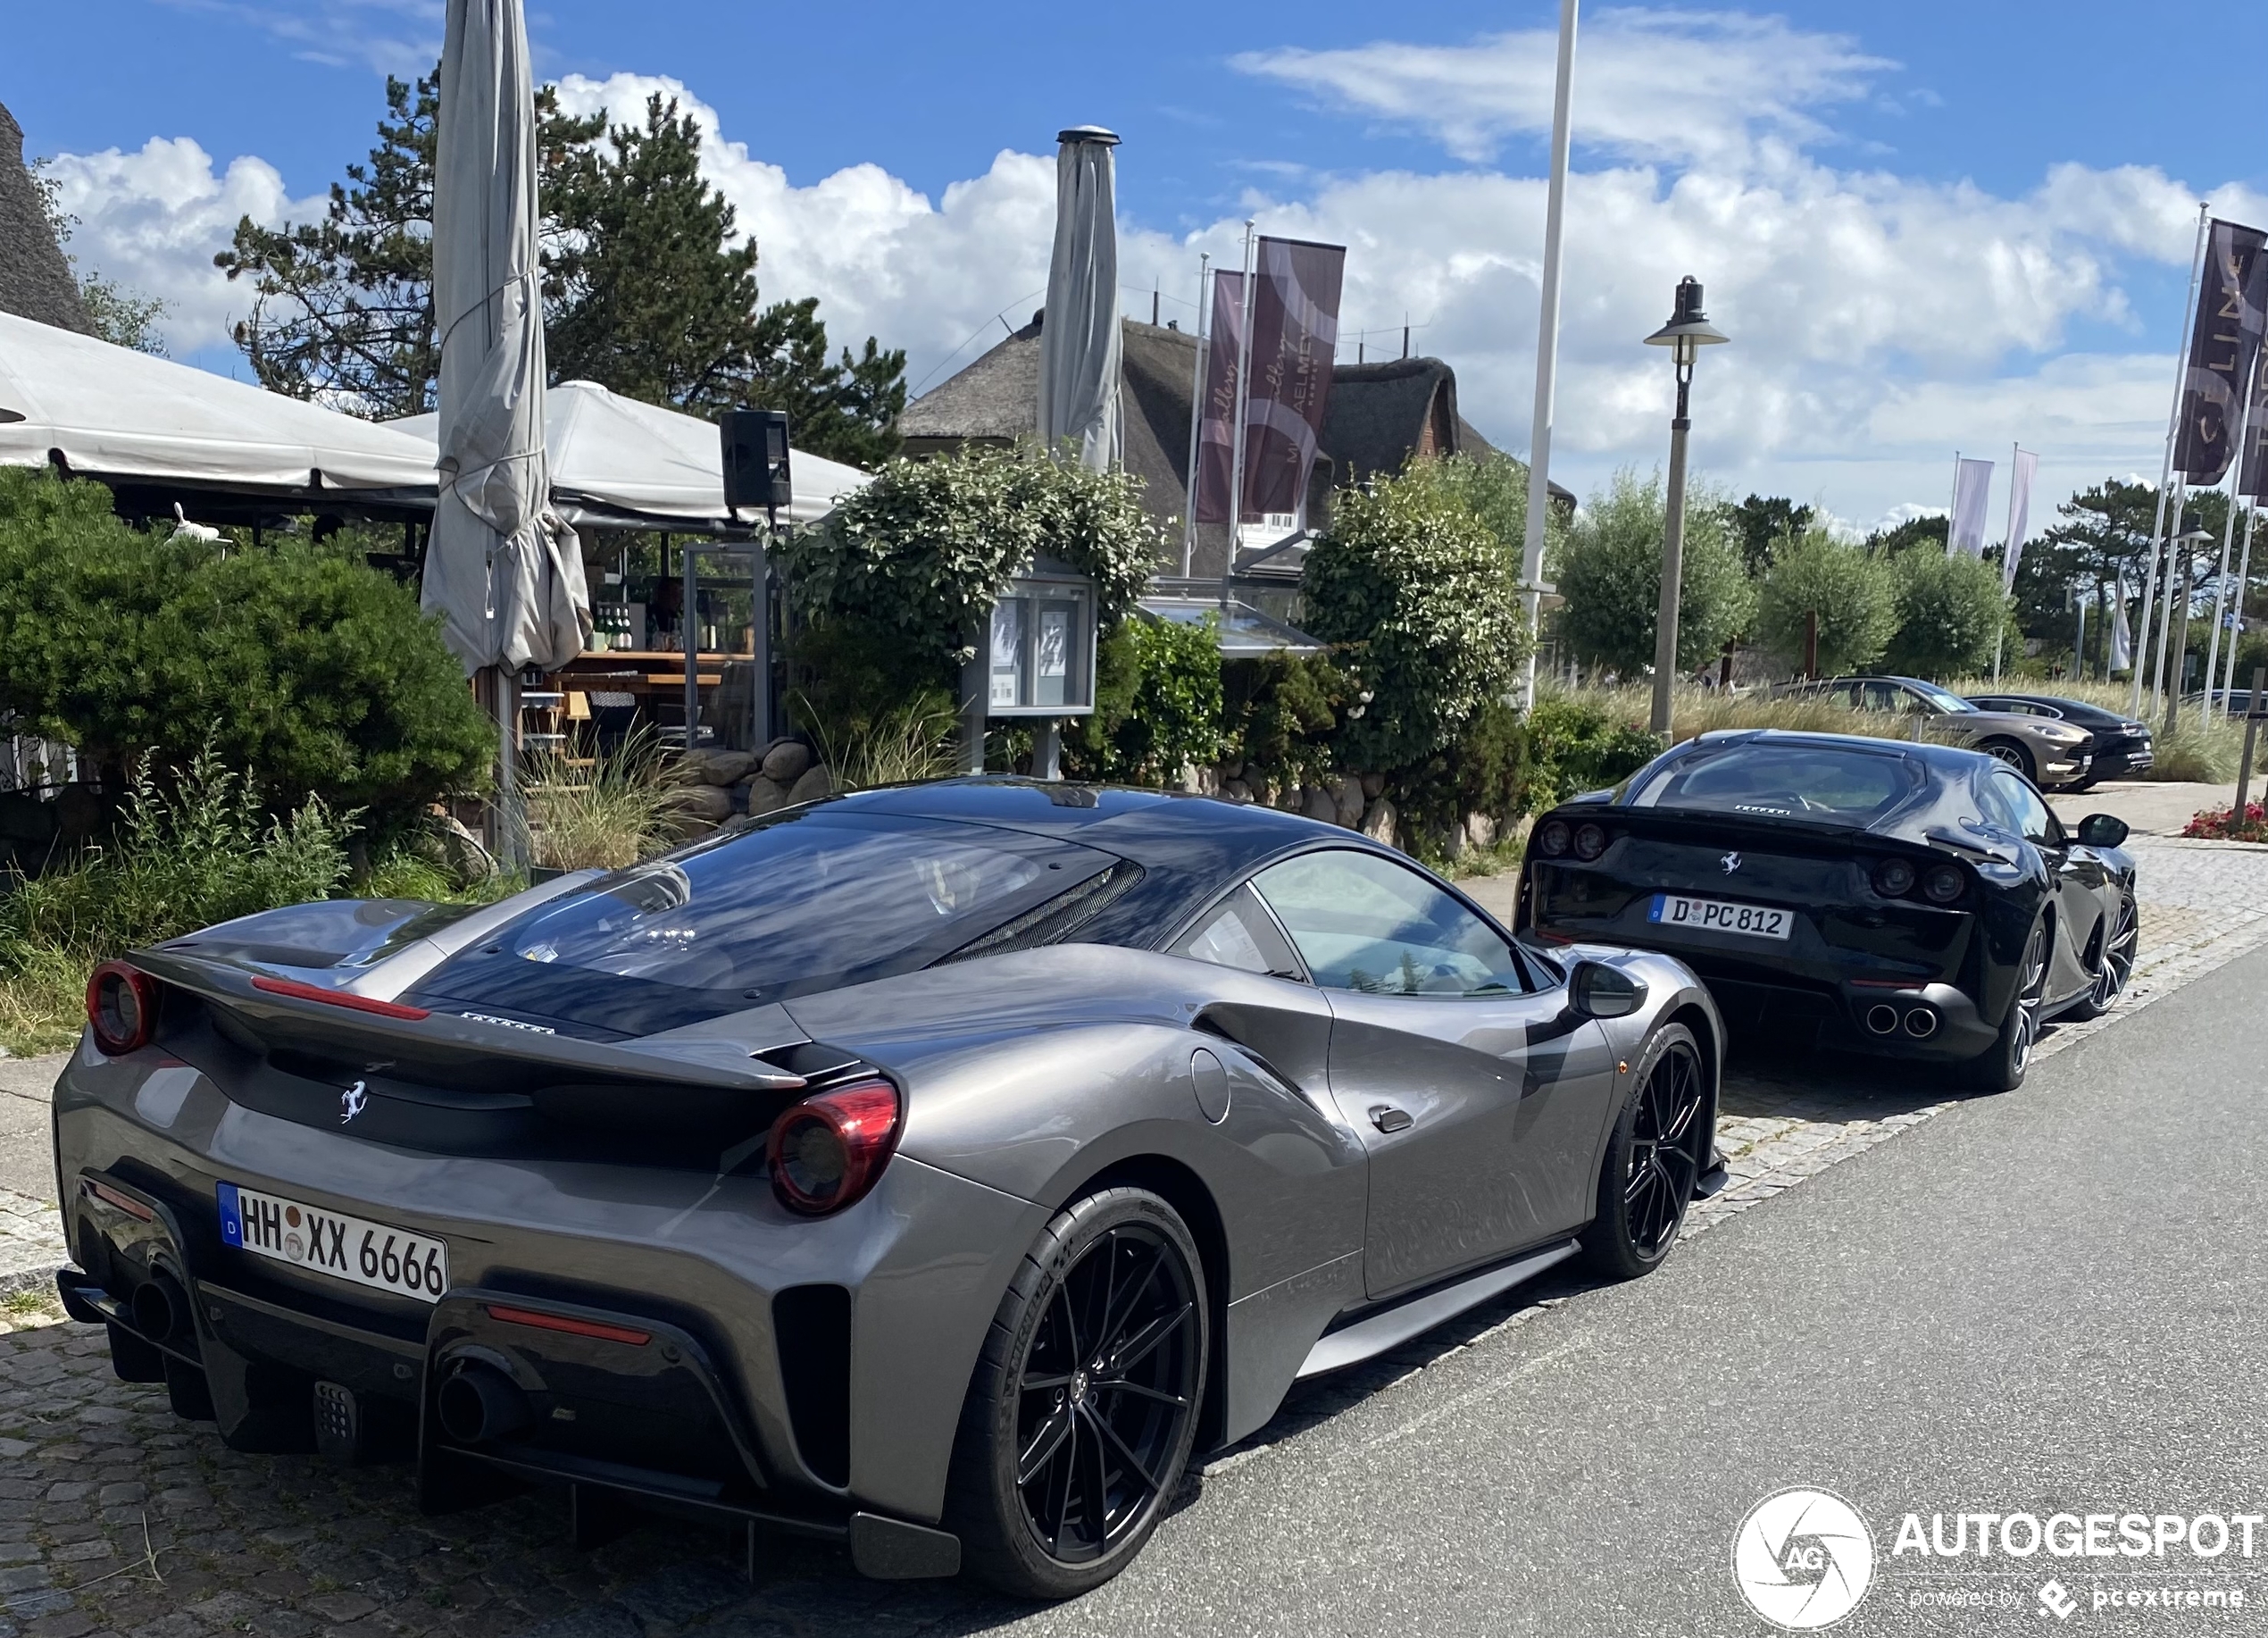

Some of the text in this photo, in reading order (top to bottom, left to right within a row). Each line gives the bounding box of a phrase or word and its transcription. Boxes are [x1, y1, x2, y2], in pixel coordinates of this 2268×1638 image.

[1265, 331, 1298, 404] allery
[1672, 899, 1782, 934] D PC 812
[227, 1221, 237, 1234] D
[240, 1195, 443, 1296] HH XX 6666
